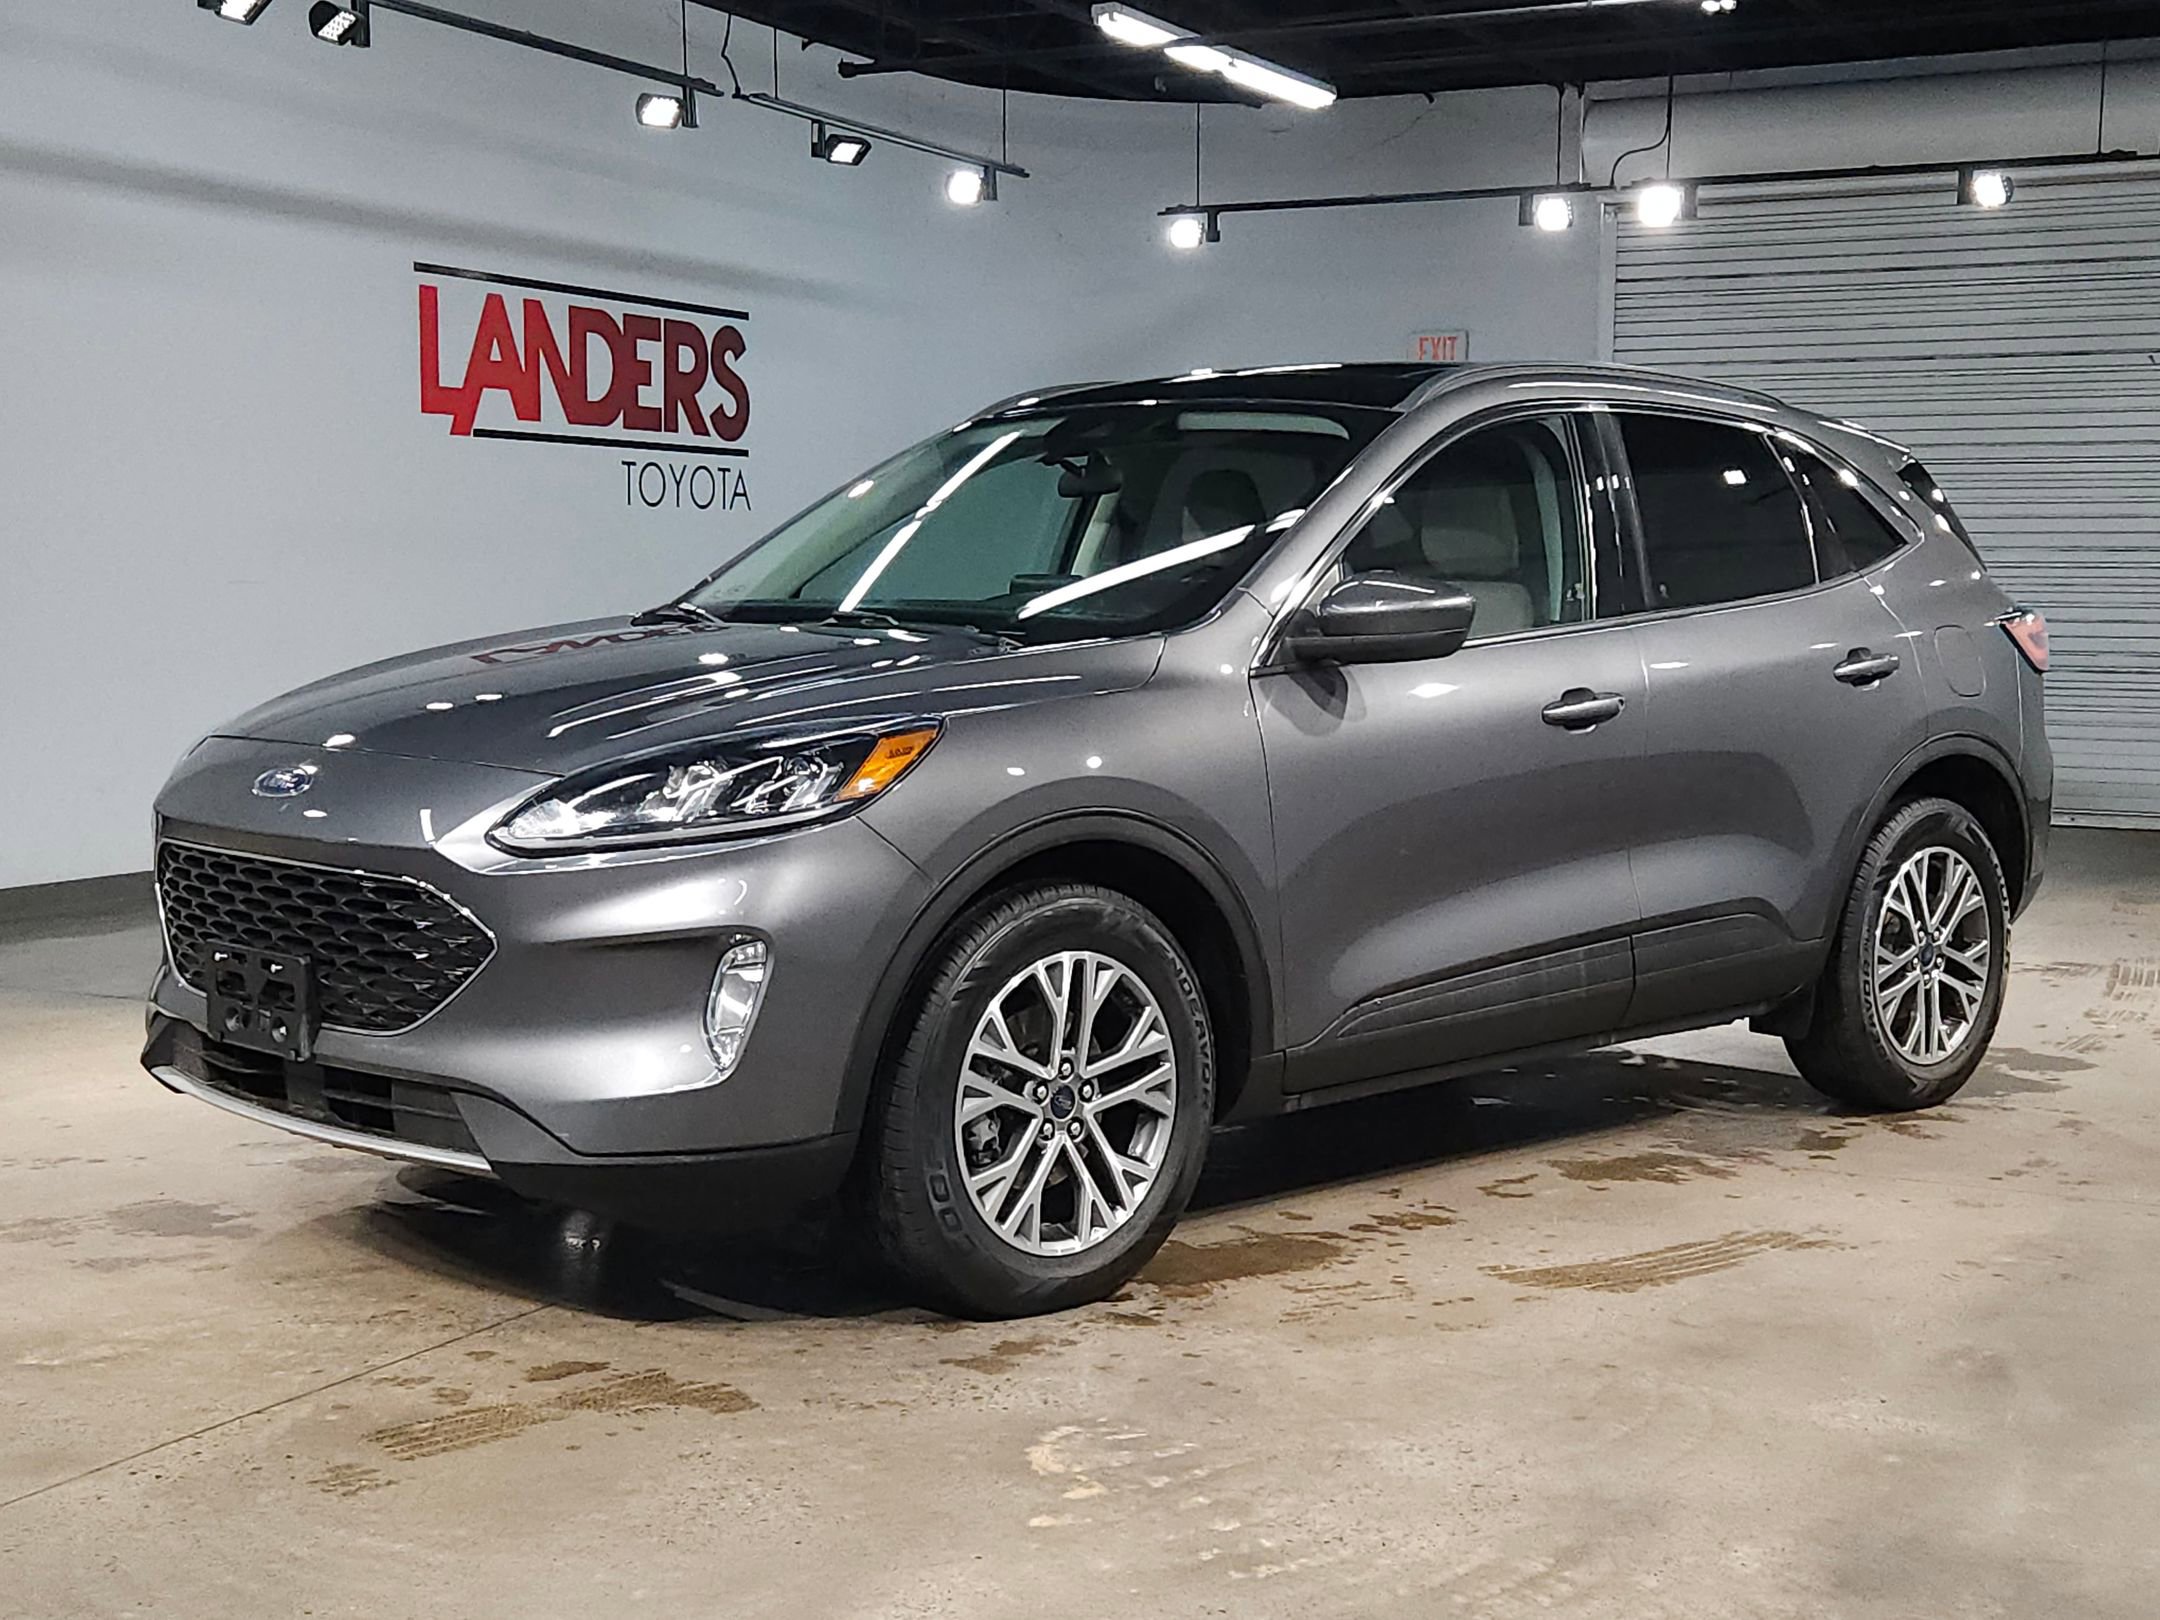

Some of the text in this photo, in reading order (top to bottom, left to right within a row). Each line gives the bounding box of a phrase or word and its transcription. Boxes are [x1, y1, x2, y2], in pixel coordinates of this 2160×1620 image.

[419, 285, 750, 442] LANDERS
[1418, 335, 1457, 361] EXIT
[621, 460, 751, 511] TOYOTA
